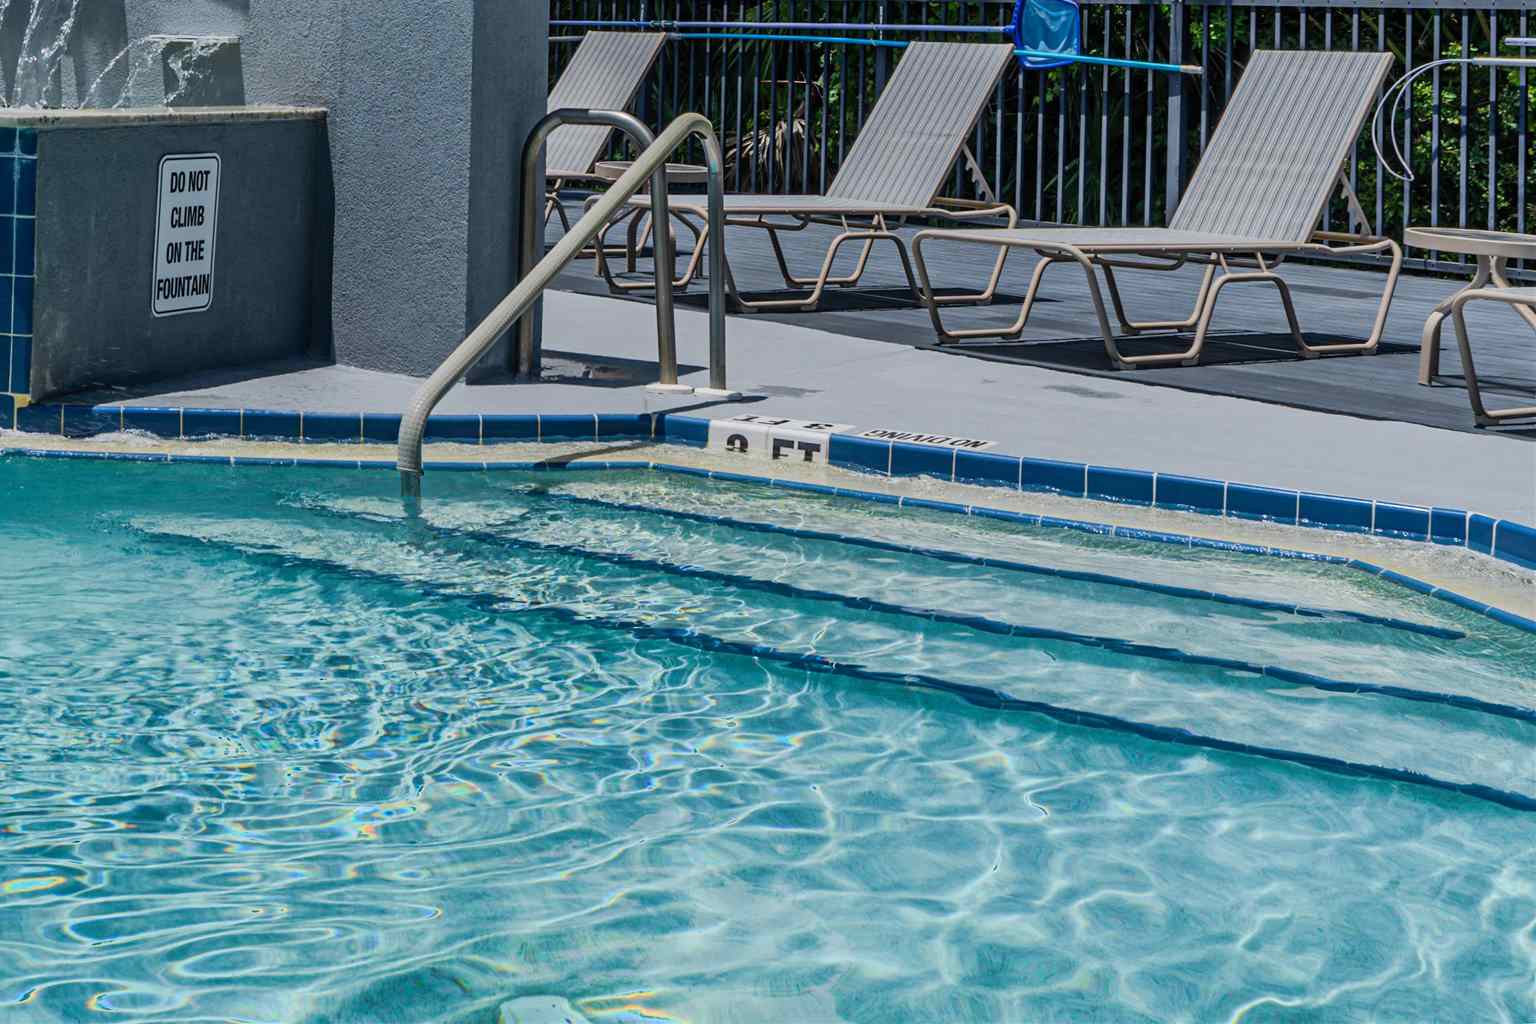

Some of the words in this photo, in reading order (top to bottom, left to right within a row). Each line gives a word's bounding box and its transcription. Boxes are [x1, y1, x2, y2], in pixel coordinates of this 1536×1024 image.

[169, 171, 186, 193] DO
[188, 170, 211, 193] NOT
[170, 205, 205, 229] CLIMB
[166, 241, 182, 264] ON
[184, 239, 205, 261] THE
[156, 273, 210, 300] FOUNTAIN
[864, 429, 953, 445] DIVING
[949, 438, 989, 449] NO
[772, 437, 821, 462] FT
